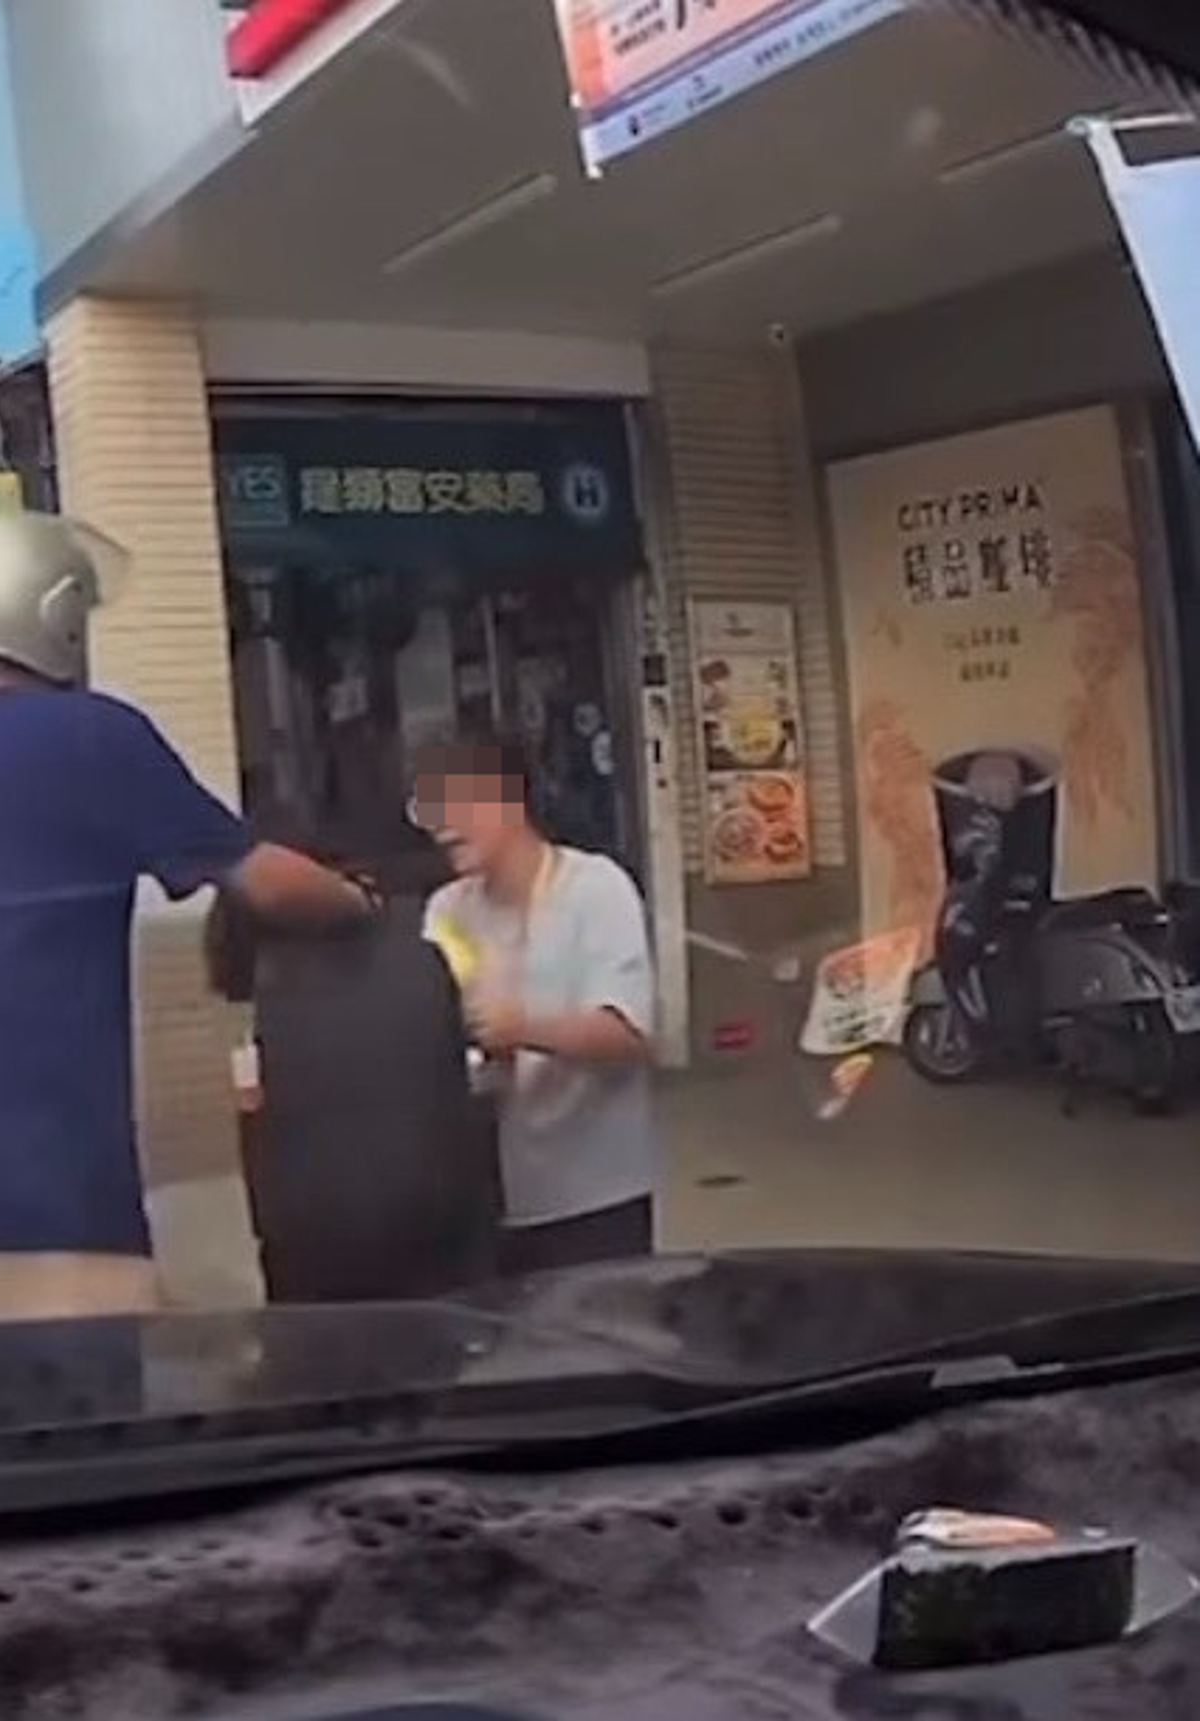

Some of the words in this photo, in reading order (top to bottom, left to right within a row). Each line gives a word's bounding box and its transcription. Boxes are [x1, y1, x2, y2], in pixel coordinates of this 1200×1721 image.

[898, 500, 952, 532] CITY
[960, 483, 1045, 517] PRMA
[903, 527, 1052, 604] 精品咖啡
